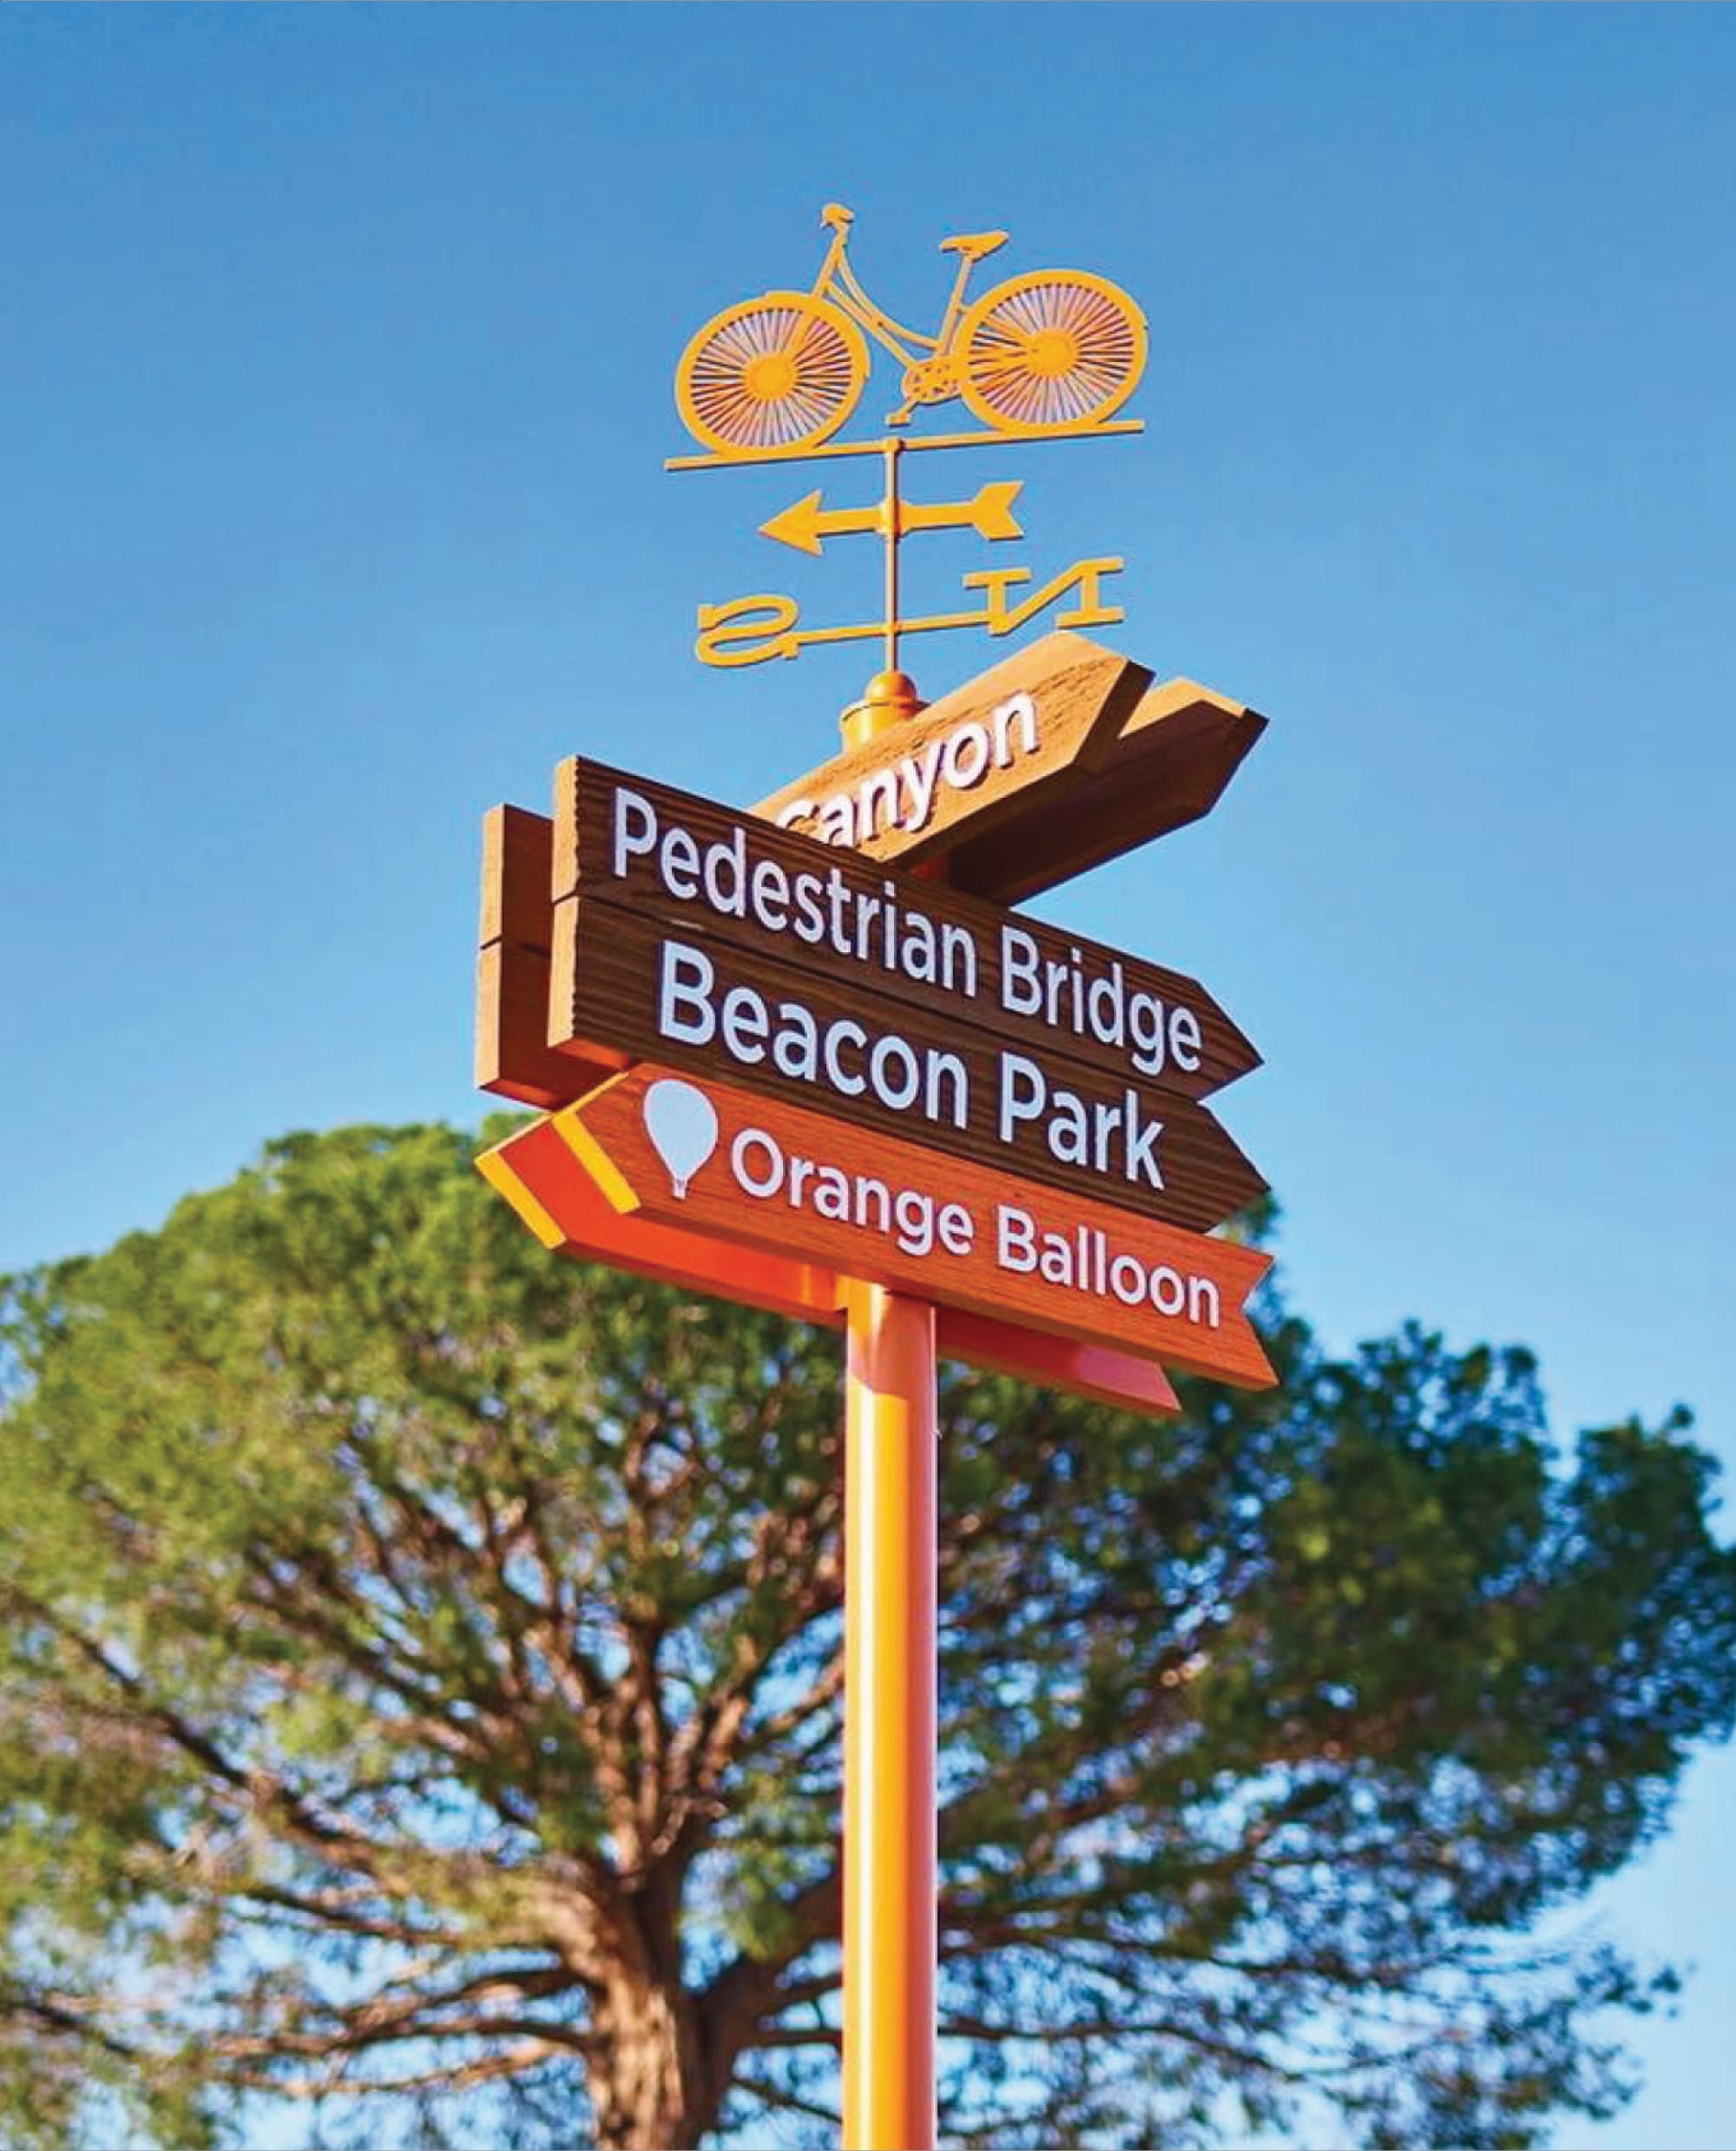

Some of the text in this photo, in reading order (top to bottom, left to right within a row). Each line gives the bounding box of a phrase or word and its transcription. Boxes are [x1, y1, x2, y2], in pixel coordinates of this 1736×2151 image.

[614, 787, 1202, 1075] Pedestrian Bridge
[660, 939, 1165, 1190] Beacon Park
[731, 1128, 1220, 1328] Orange Balloon
